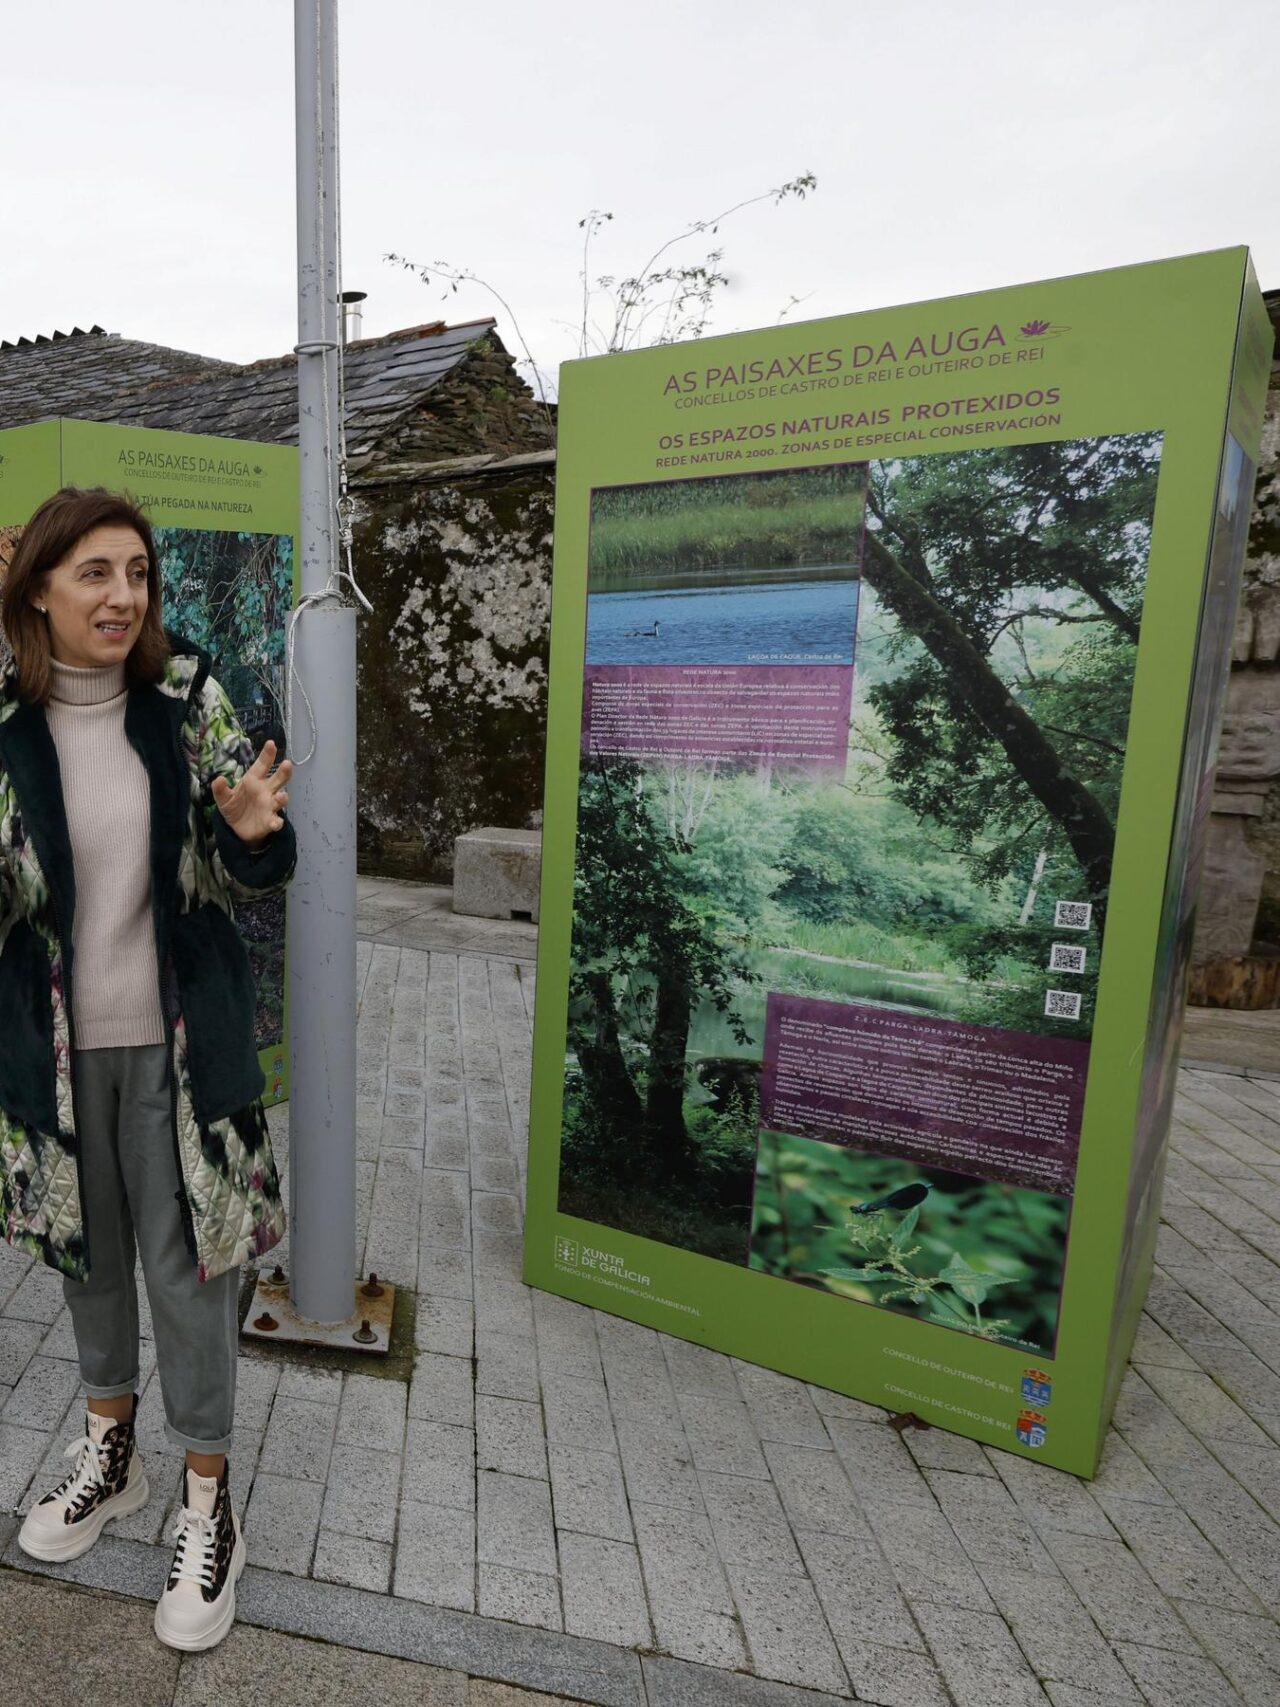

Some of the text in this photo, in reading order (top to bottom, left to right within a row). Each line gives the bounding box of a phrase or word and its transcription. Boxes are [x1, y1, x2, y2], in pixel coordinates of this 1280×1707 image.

[663, 324, 1006, 396] AS PAISAXES DA AUGA
[674, 347, 1044, 409] CONCELLOS DE CASTRO DE REI E OUTEIRO DE REI
[656, 413, 1061, 468] REDE NATURA 2000. ZONAS DE ESPECIAL CONSERVACIÓN
[659, 388, 1060, 449] OS ESPAZOS NATURAIS PROTEXIDOS
[118, 449, 250, 476] AS PAISAXES DA AUGA
[124, 467, 161, 479] CONCELLOS
[162, 497, 196, 510] PEGADA
[198, 501, 209, 510] NA
[211, 502, 253, 514] NATUREZA
[582, 1246, 624, 1267] XUNTA
[582, 1256, 650, 1286] DE GALICIA
[554, 1263, 581, 1277] FONDO
[582, 1271, 591, 1280] DE
[655, 1297, 701, 1317] AMBIENTAL
[883, 1347, 1014, 1394] CONCELLO DE OUTEIRO DE REI
[884, 1383, 1011, 1431] CONCELLO DE CASTRO DE REI
